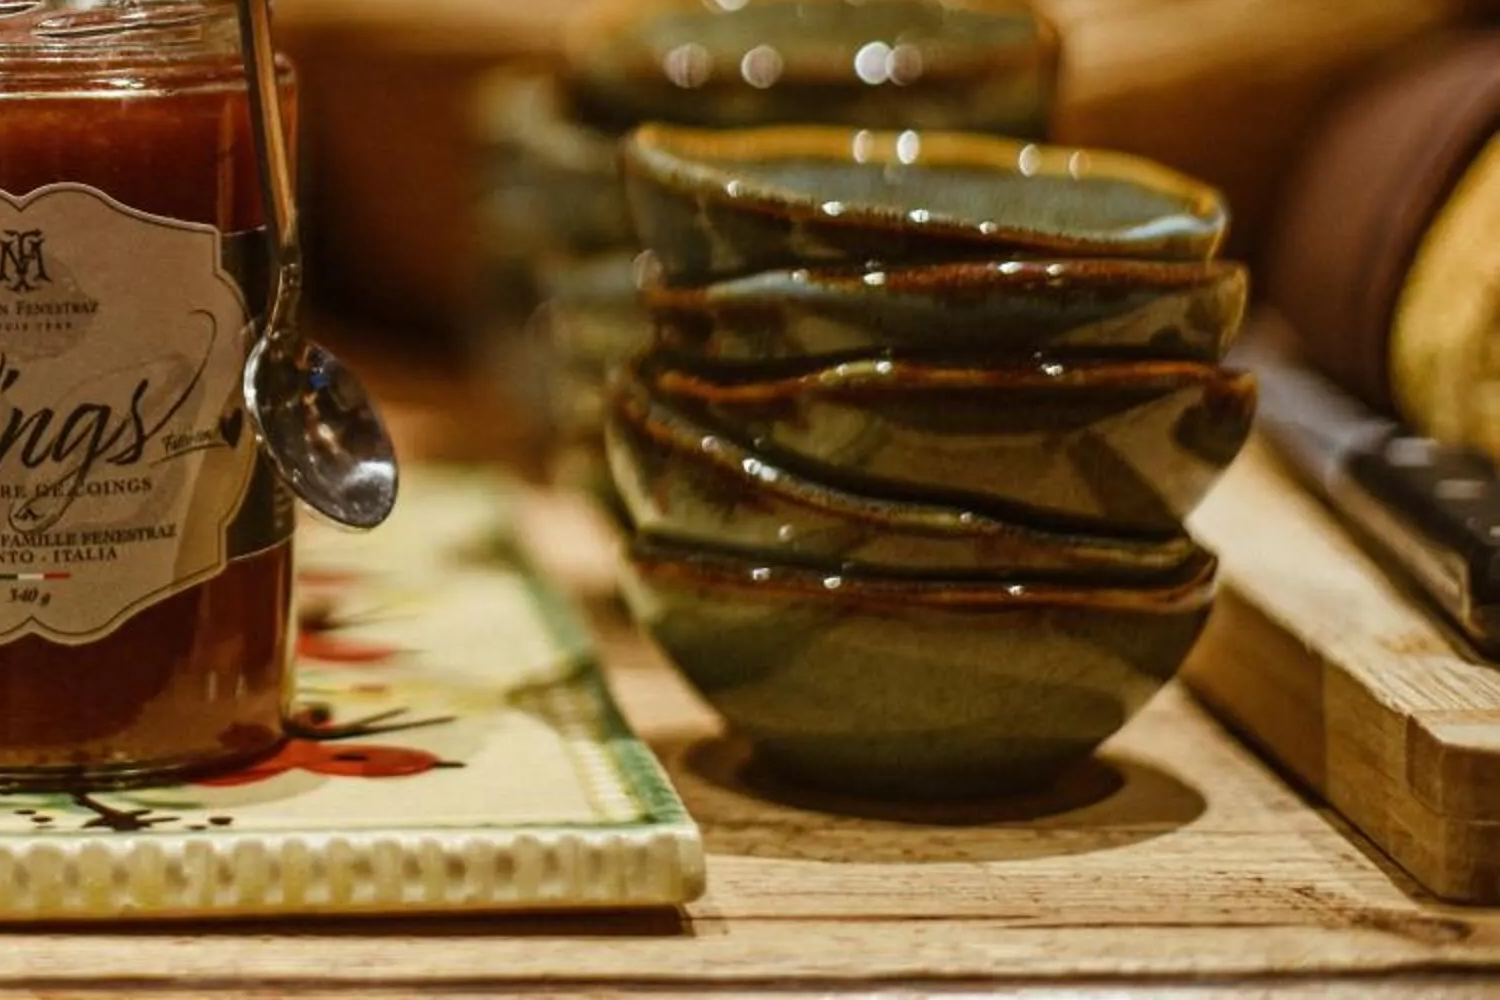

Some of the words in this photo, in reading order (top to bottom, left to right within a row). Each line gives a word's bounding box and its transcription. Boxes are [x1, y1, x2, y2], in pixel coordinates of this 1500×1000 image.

[34, 484, 64, 499] DE
[74, 477, 153, 497] COINGS
[1, 532, 77, 548] FAMILLE
[82, 523, 178, 546] FENESTRAZ
[52, 547, 118, 563] ITALIA
